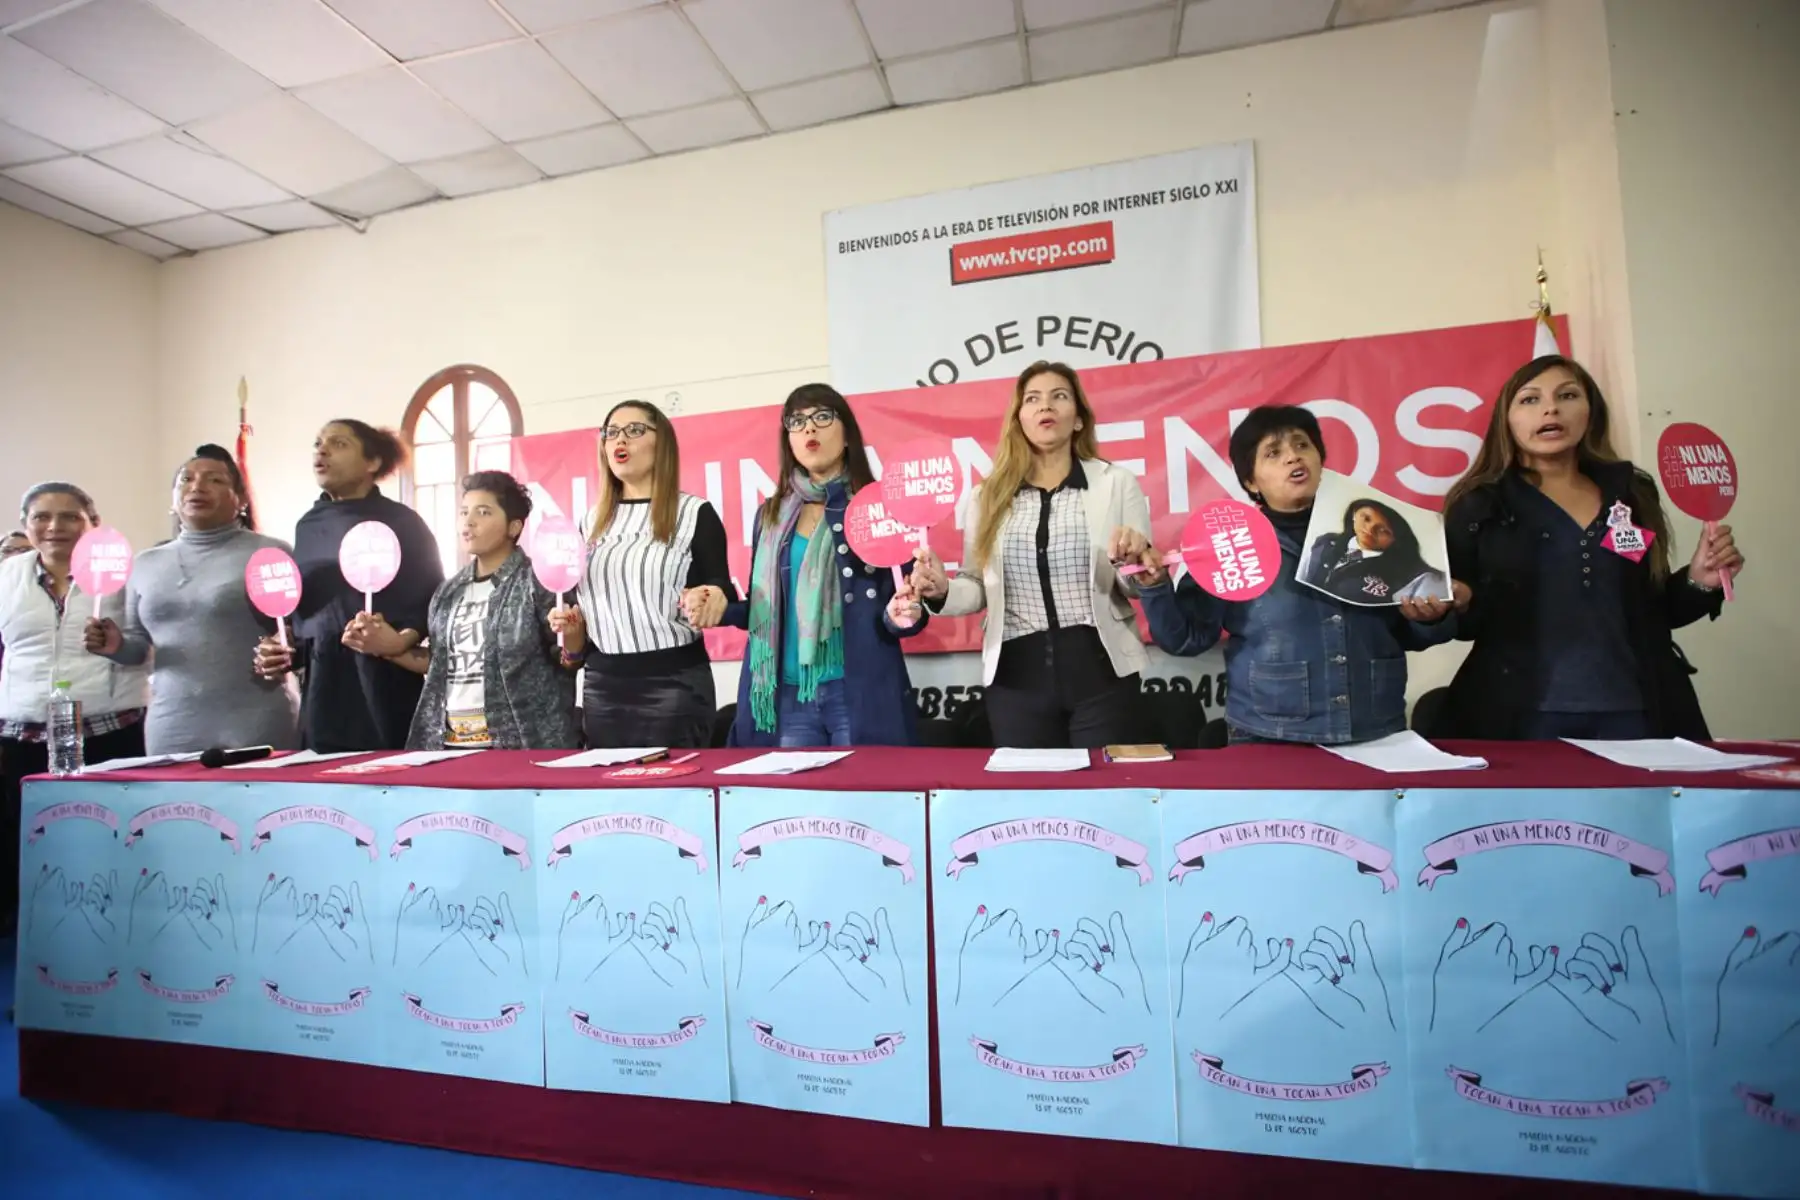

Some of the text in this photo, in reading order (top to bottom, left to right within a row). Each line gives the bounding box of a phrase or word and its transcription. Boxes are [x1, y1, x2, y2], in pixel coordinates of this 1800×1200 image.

[838, 230, 918, 254] BIENVENIDOS
[921, 228, 931, 241] A
[933, 225, 949, 239] LA
[951, 220, 975, 236] ERA
[977, 217, 994, 232] DE
[1072, 200, 1100, 218] POR
[1103, 190, 1166, 213] INTERNET
[1169, 183, 1211, 203] SIGLO
[1214, 178, 1239, 196] XXI
[959, 236, 1108, 271] www.tvcpp.com
[964, 320, 1024, 366] DE
[921, 455, 954, 477] UNA
[1696, 443, 1728, 464] UNA
[904, 476, 955, 497] MENOS
[1685, 466, 1732, 486] MENOS
[1210, 532, 1245, 591] MENOS
[1238, 548, 1265, 588] UNA
[786, 820, 805, 834] UNA
[808, 819, 840, 835] MENOS
[991, 828, 1003, 841] NI
[1006, 823, 1028, 837] UNA
[1032, 821, 1069, 836] MENOS
[1220, 832, 1232, 844] NI
[1236, 825, 1260, 841] UNA
[1264, 824, 1305, 839] MENOS
[1474, 824, 1609, 848] NI UNA MENOS PERU
[984, 1052, 1131, 1080] TOCAN A UNA TOCAN A TODAS
[1207, 1067, 1370, 1099] TOCAN A UNA TOCAN A TODAS
[1464, 1083, 1500, 1106] TOCAN
[1507, 1100, 1513, 1109] A
[1519, 1101, 1541, 1113] UNA
[1552, 1105, 1591, 1117] TOCAN
[1597, 1105, 1604, 1113] A
